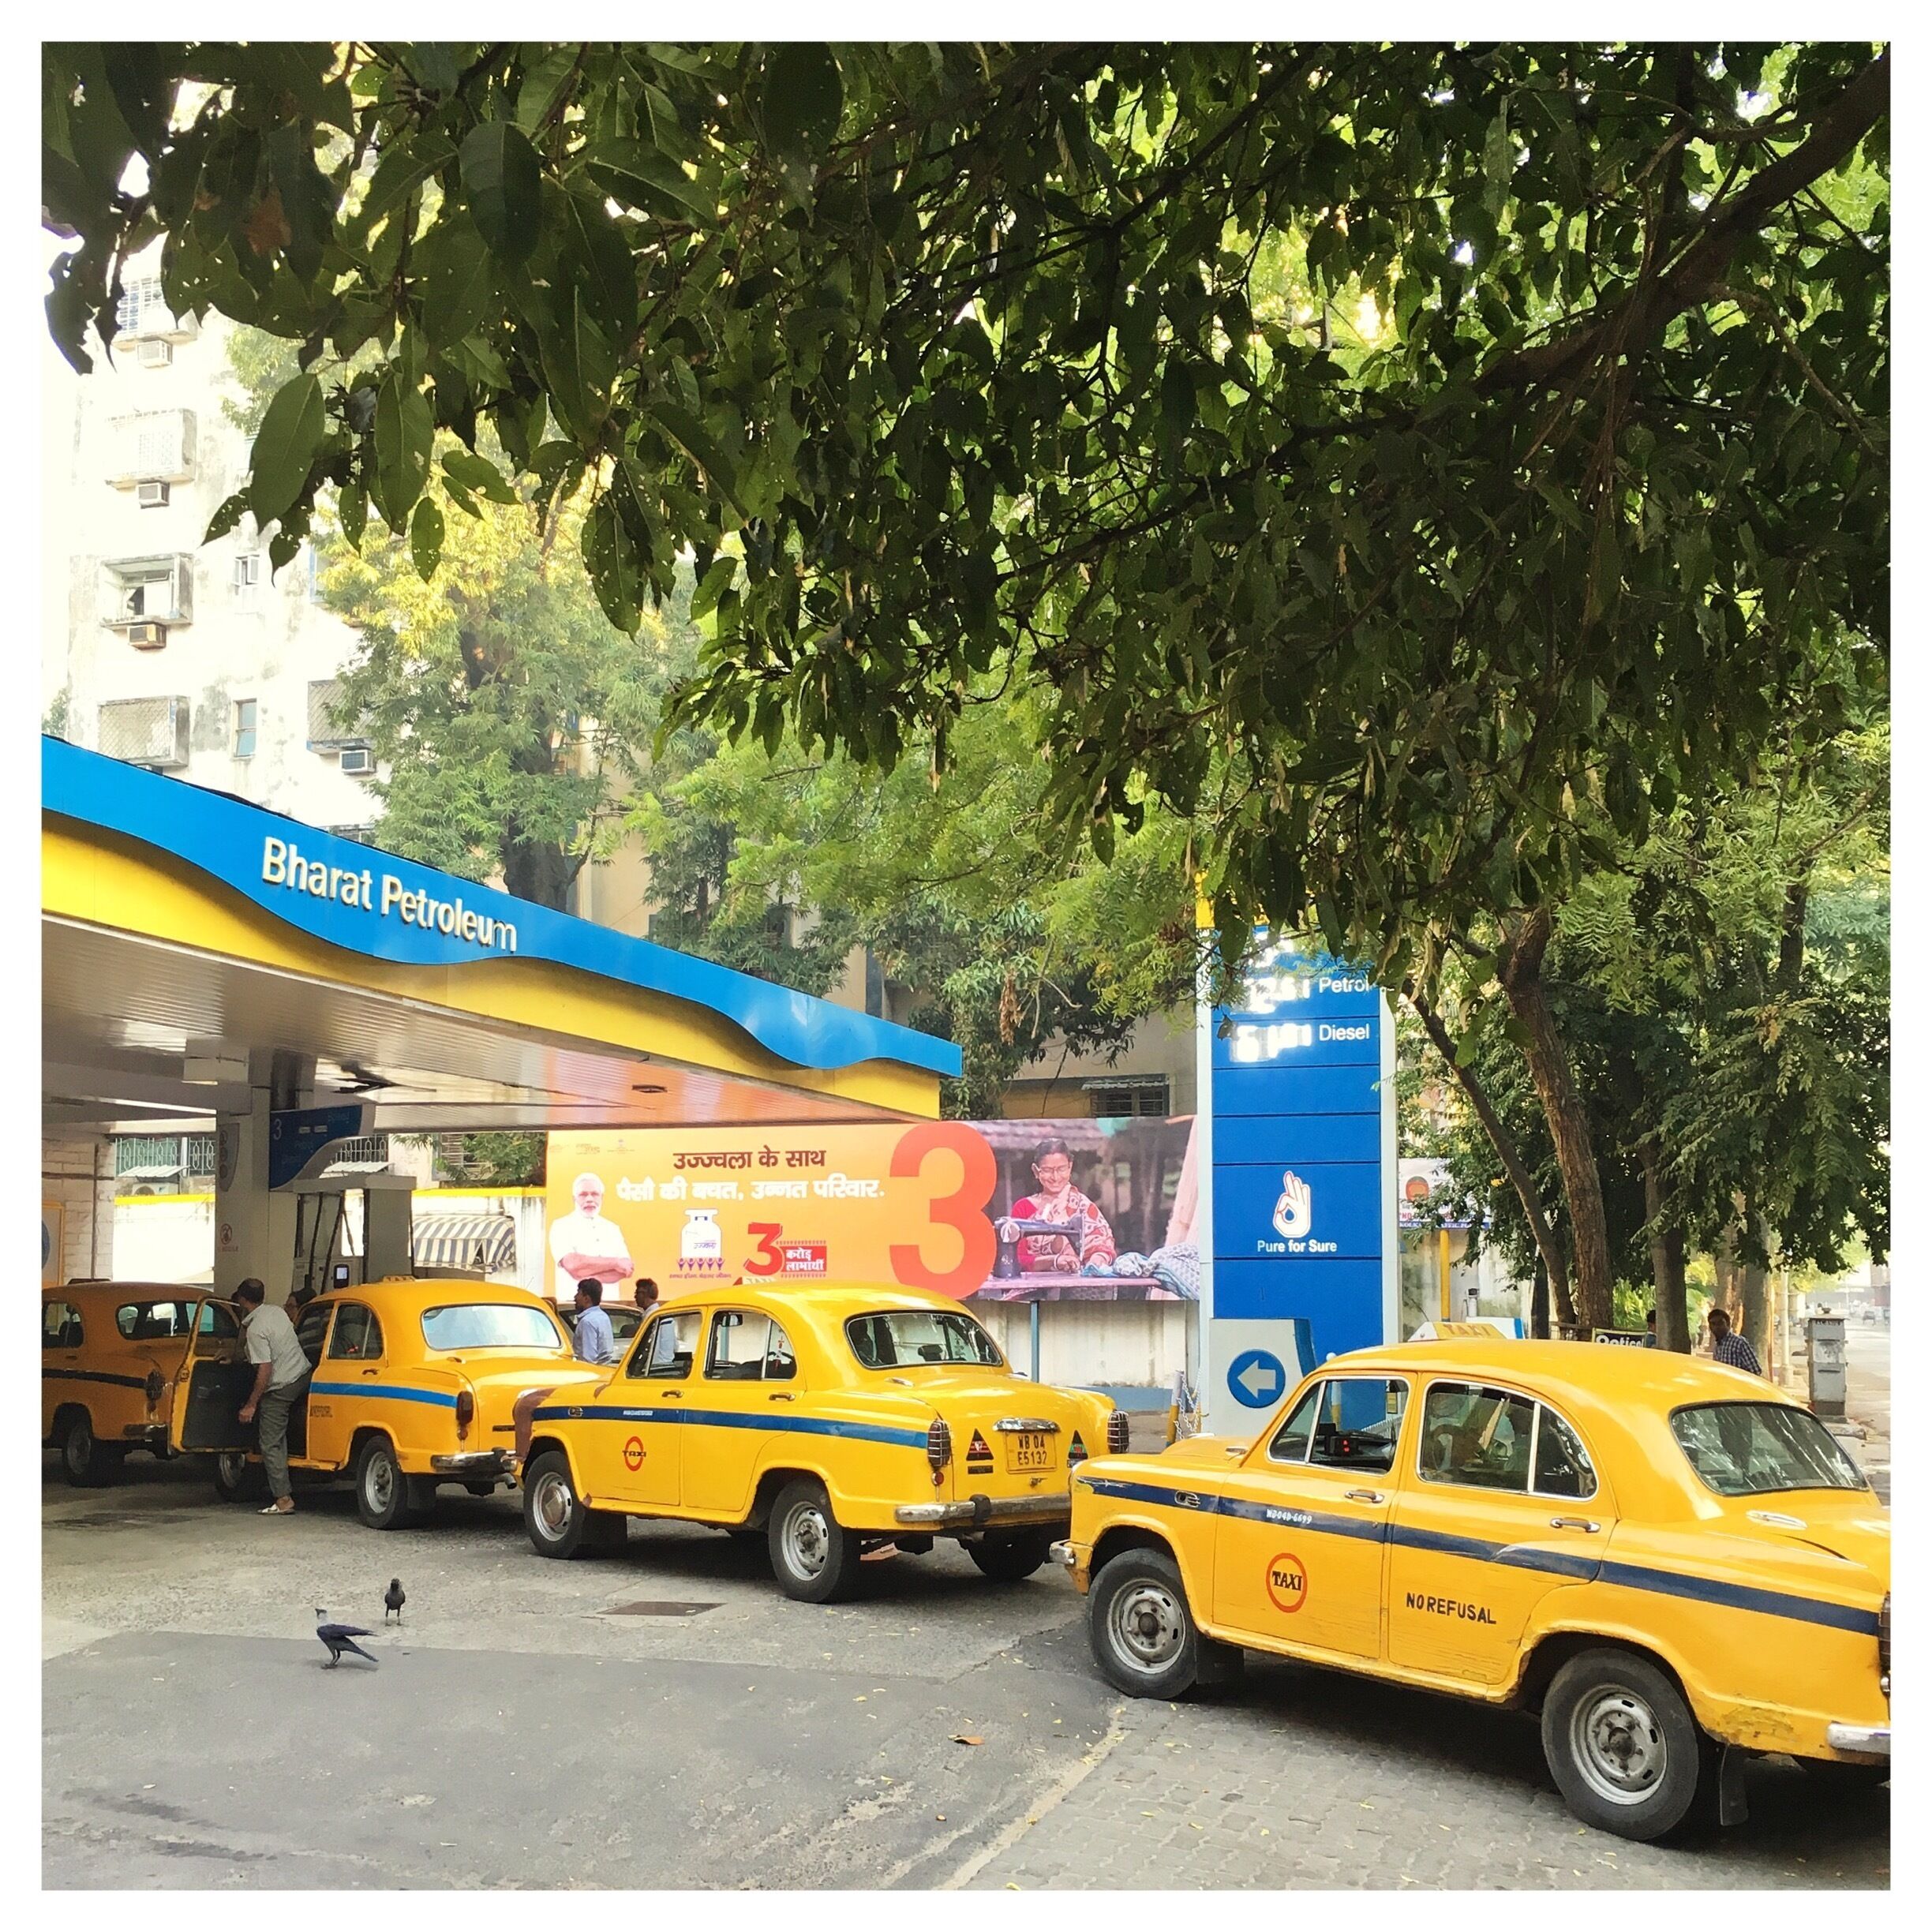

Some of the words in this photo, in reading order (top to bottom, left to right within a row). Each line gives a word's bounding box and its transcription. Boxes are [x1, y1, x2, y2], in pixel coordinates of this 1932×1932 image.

[262, 837, 373, 910] Bharat
[381, 874, 517, 952] Petroleum
[1319, 977, 1369, 994] Petrol
[1319, 1024, 1370, 1041] Diesel
[273, 1118, 282, 1140] 3
[673, 1151, 752, 1170] उज्ज्वला
[759, 1144, 780, 1168] के
[785, 1150, 826, 1167] साथ
[659, 1175, 687, 1200] की
[751, 1181, 809, 1200] उन्नत
[889, 1121, 997, 1299] 3
[743, 1222, 783, 1276] 3
[1257, 1240, 1285, 1252] Pure
[1288, 1239, 1305, 1252] for
[1309, 1239, 1338, 1252] Sure
[1443, 1324, 1491, 1338] TAXI
[1017, 1435, 1029, 1450] WB
[1033, 1433, 1045, 1449] 04
[1017, 1451, 1047, 1466] E5132
[1272, 1571, 1302, 1591] TAXI
[1406, 1592, 1425, 1610] NO
[1427, 1597, 1496, 1624] REFUSAL
